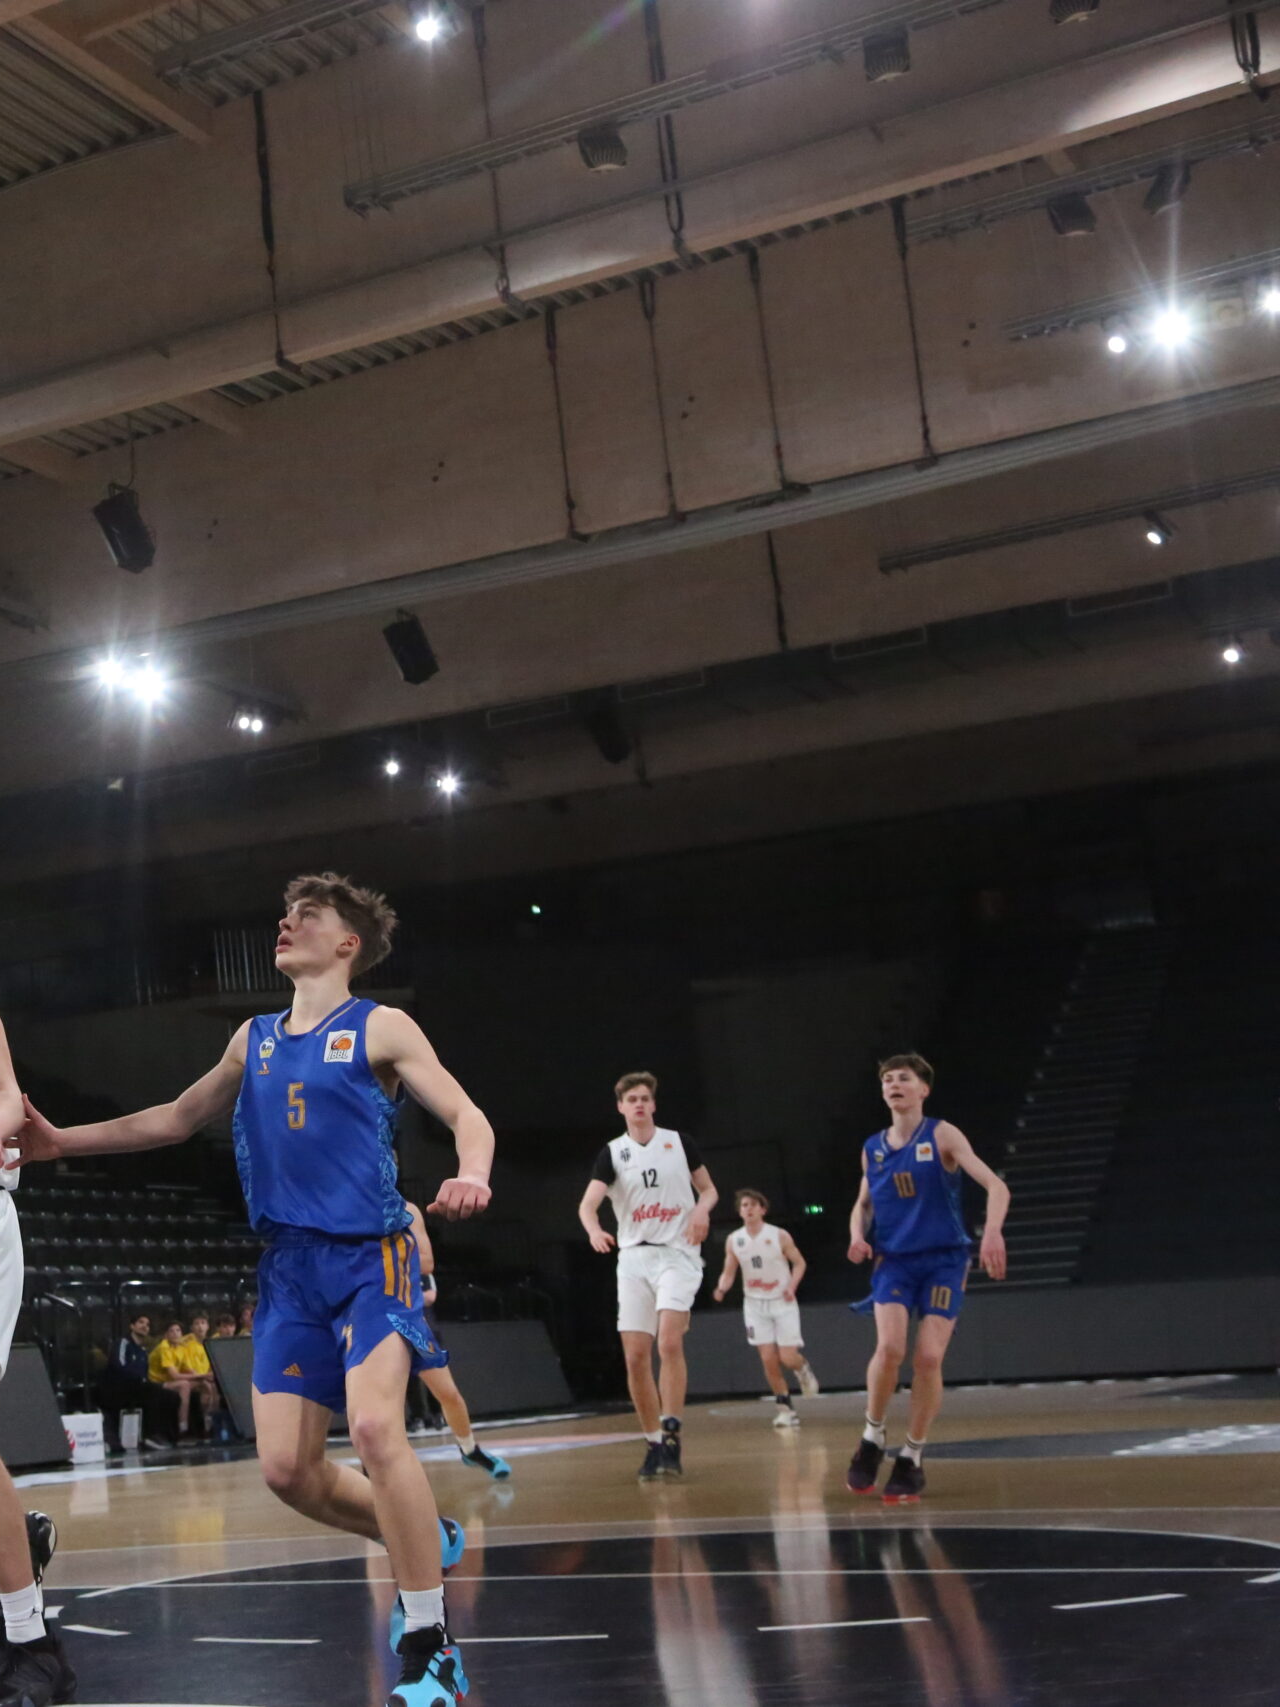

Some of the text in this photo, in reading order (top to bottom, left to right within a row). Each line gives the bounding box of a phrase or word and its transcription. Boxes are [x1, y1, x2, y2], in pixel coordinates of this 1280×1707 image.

[287, 1081, 306, 1130] 5
[641, 1168, 660, 1189] 12
[893, 1171, 916, 1199] 10
[930, 1285, 952, 1311] 10
